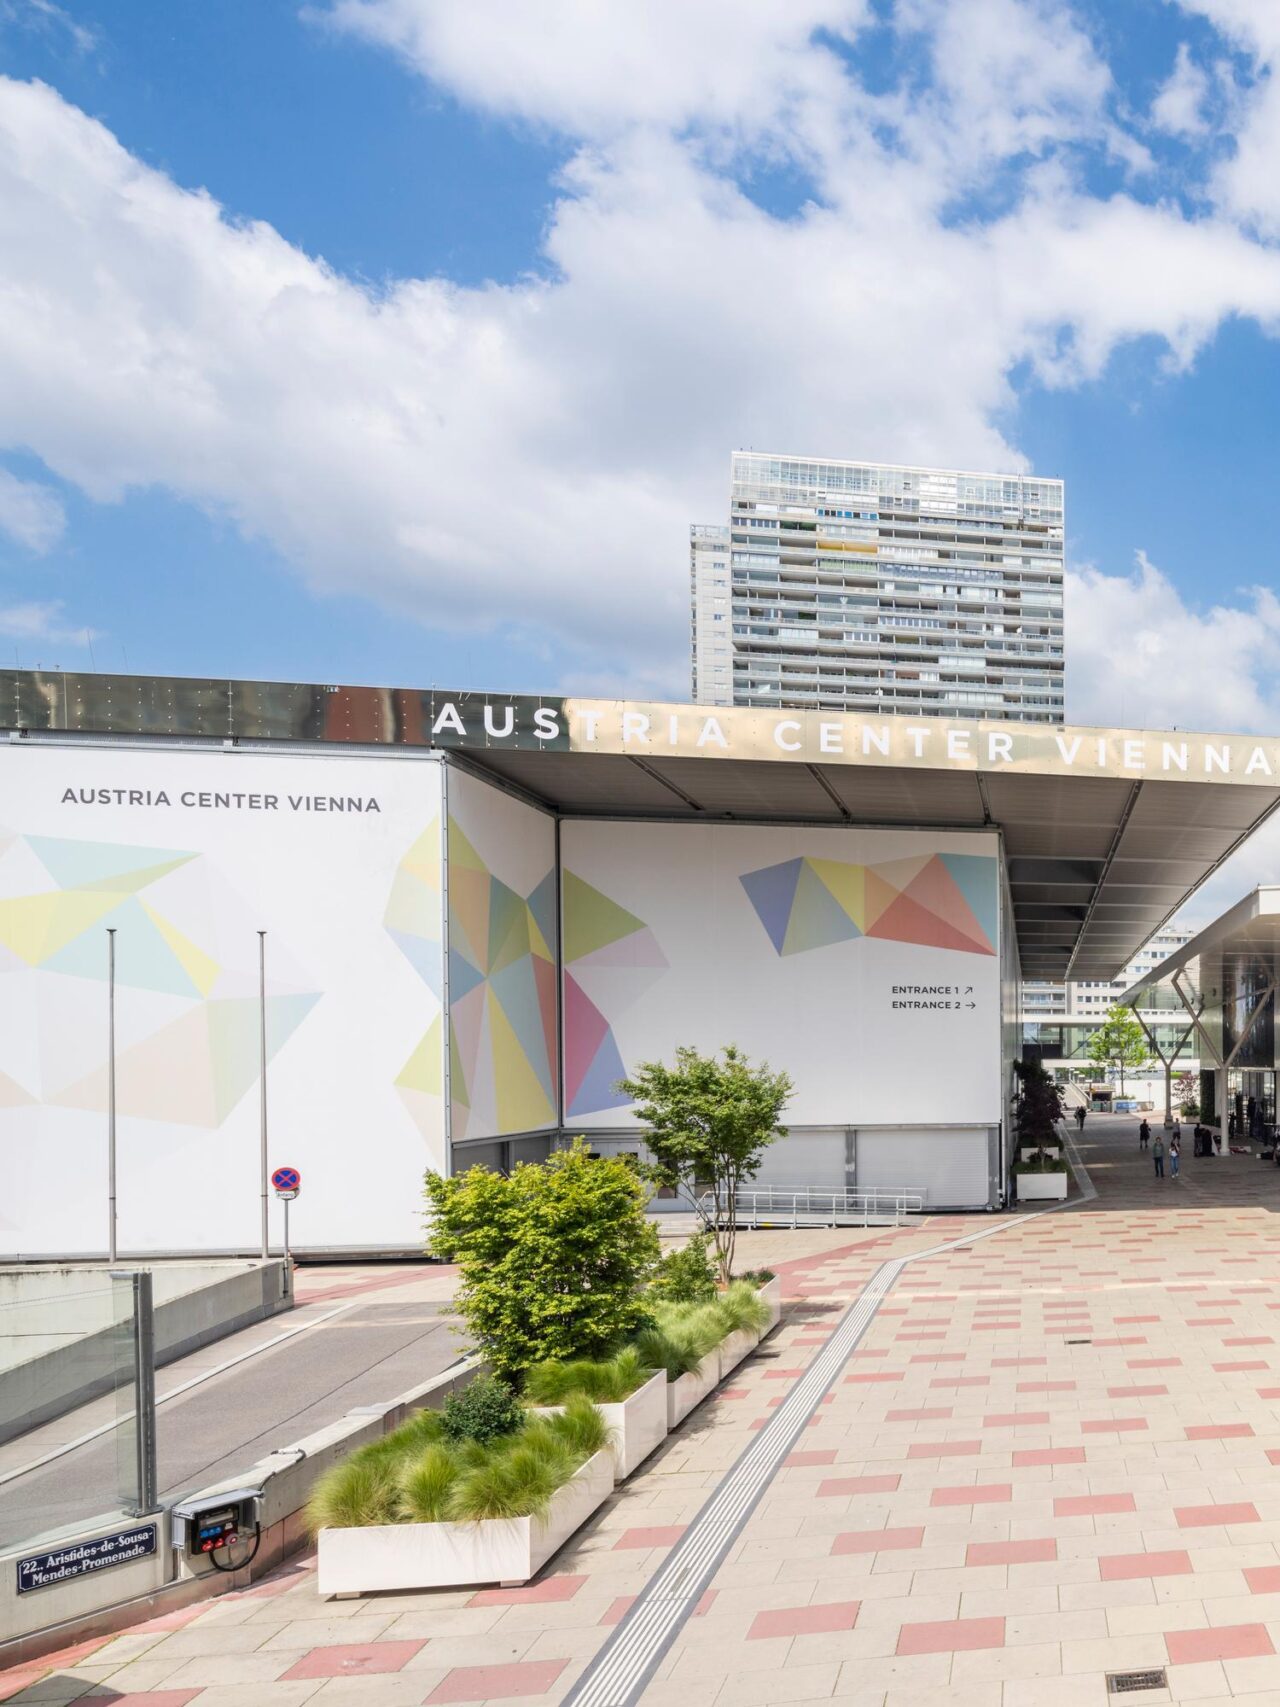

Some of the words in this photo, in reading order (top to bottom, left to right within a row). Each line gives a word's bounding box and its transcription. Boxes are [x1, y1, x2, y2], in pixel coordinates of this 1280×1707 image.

[431, 702, 729, 748] AUSTRIA
[773, 720, 1014, 762] CENTER
[1055, 736, 1272, 776] VIENNA
[61, 788, 172, 806] AUSTRIA
[180, 791, 280, 810] CENTER
[287, 795, 382, 813] VIENNA
[892, 986, 952, 994] ENTRANCE
[954, 986, 959, 994] 1
[892, 1001, 952, 1009] ENTRANCE
[954, 1001, 961, 1009] 2
[32, 1544, 145, 1585] Mendes-Promenade
[46, 1531, 153, 1569] Aristides-de-Sousa-
